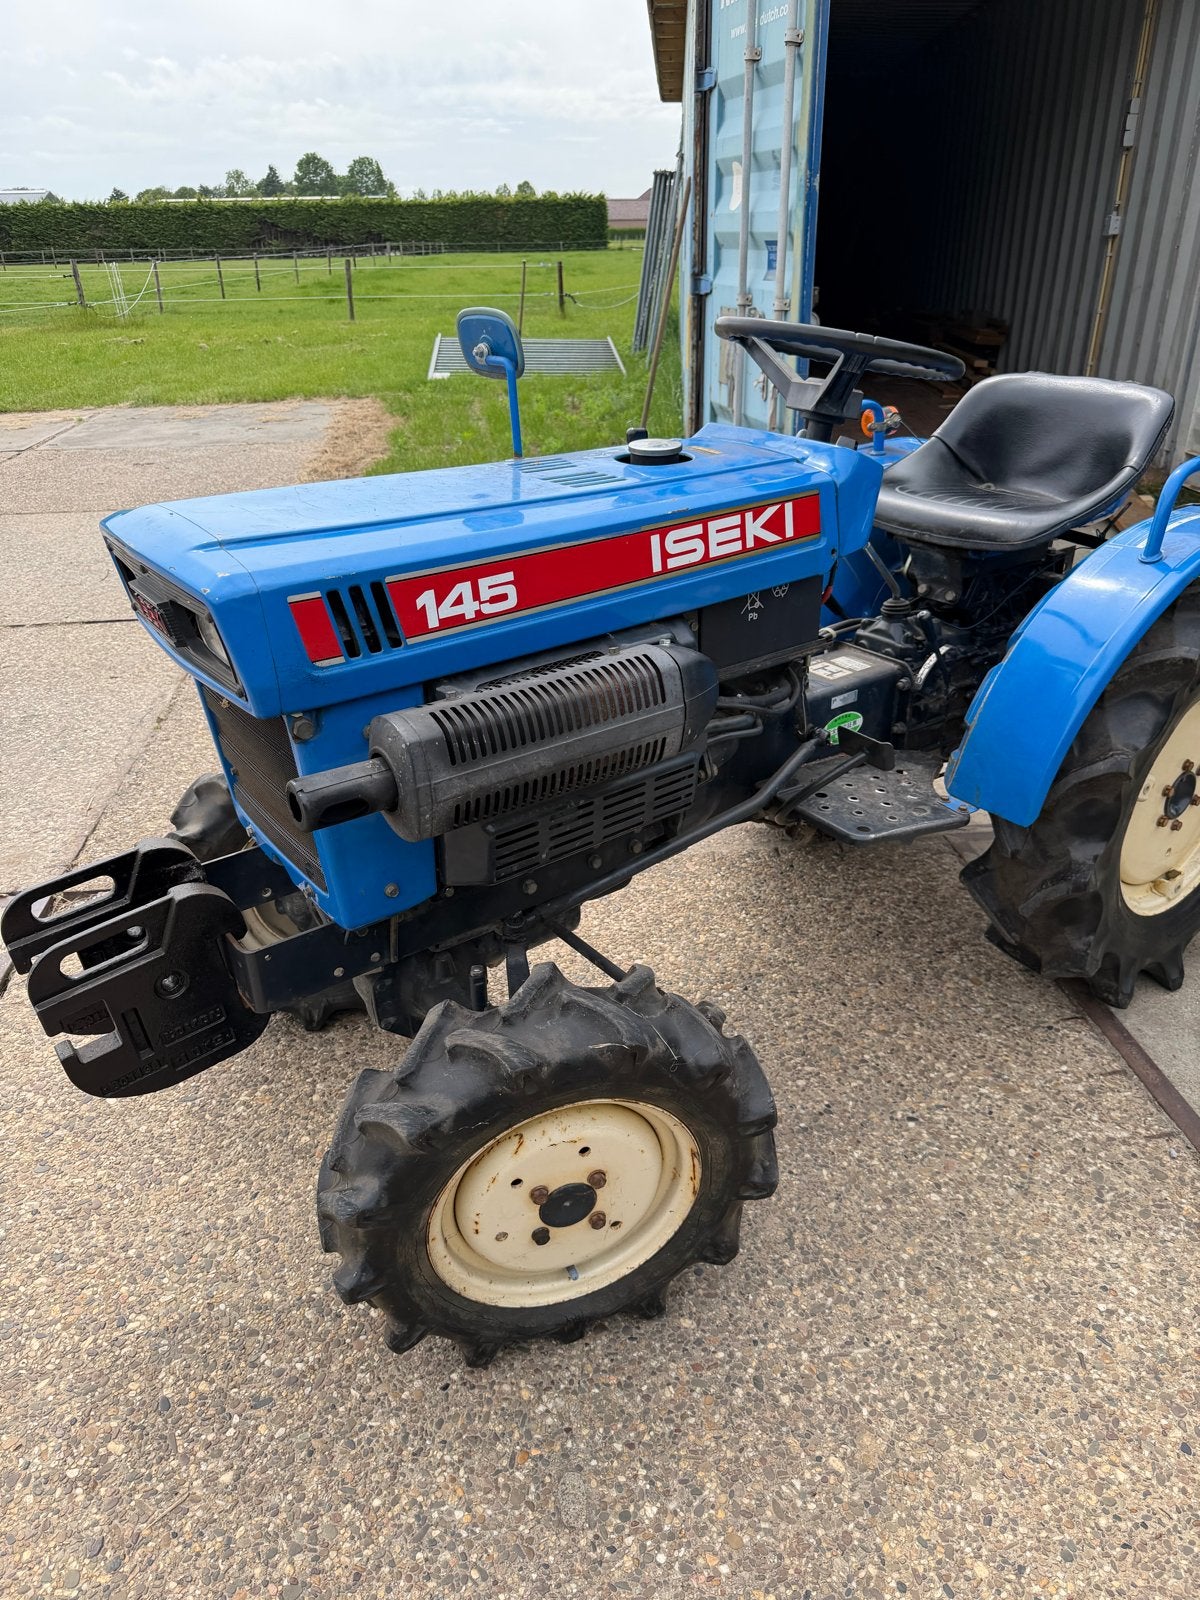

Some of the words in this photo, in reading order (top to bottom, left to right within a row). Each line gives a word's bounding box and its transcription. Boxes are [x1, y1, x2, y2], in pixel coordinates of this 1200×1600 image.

[650, 501, 794, 573] ISEKI
[416, 571, 518, 629] 145
[748, 612, 758, 621] Pb
